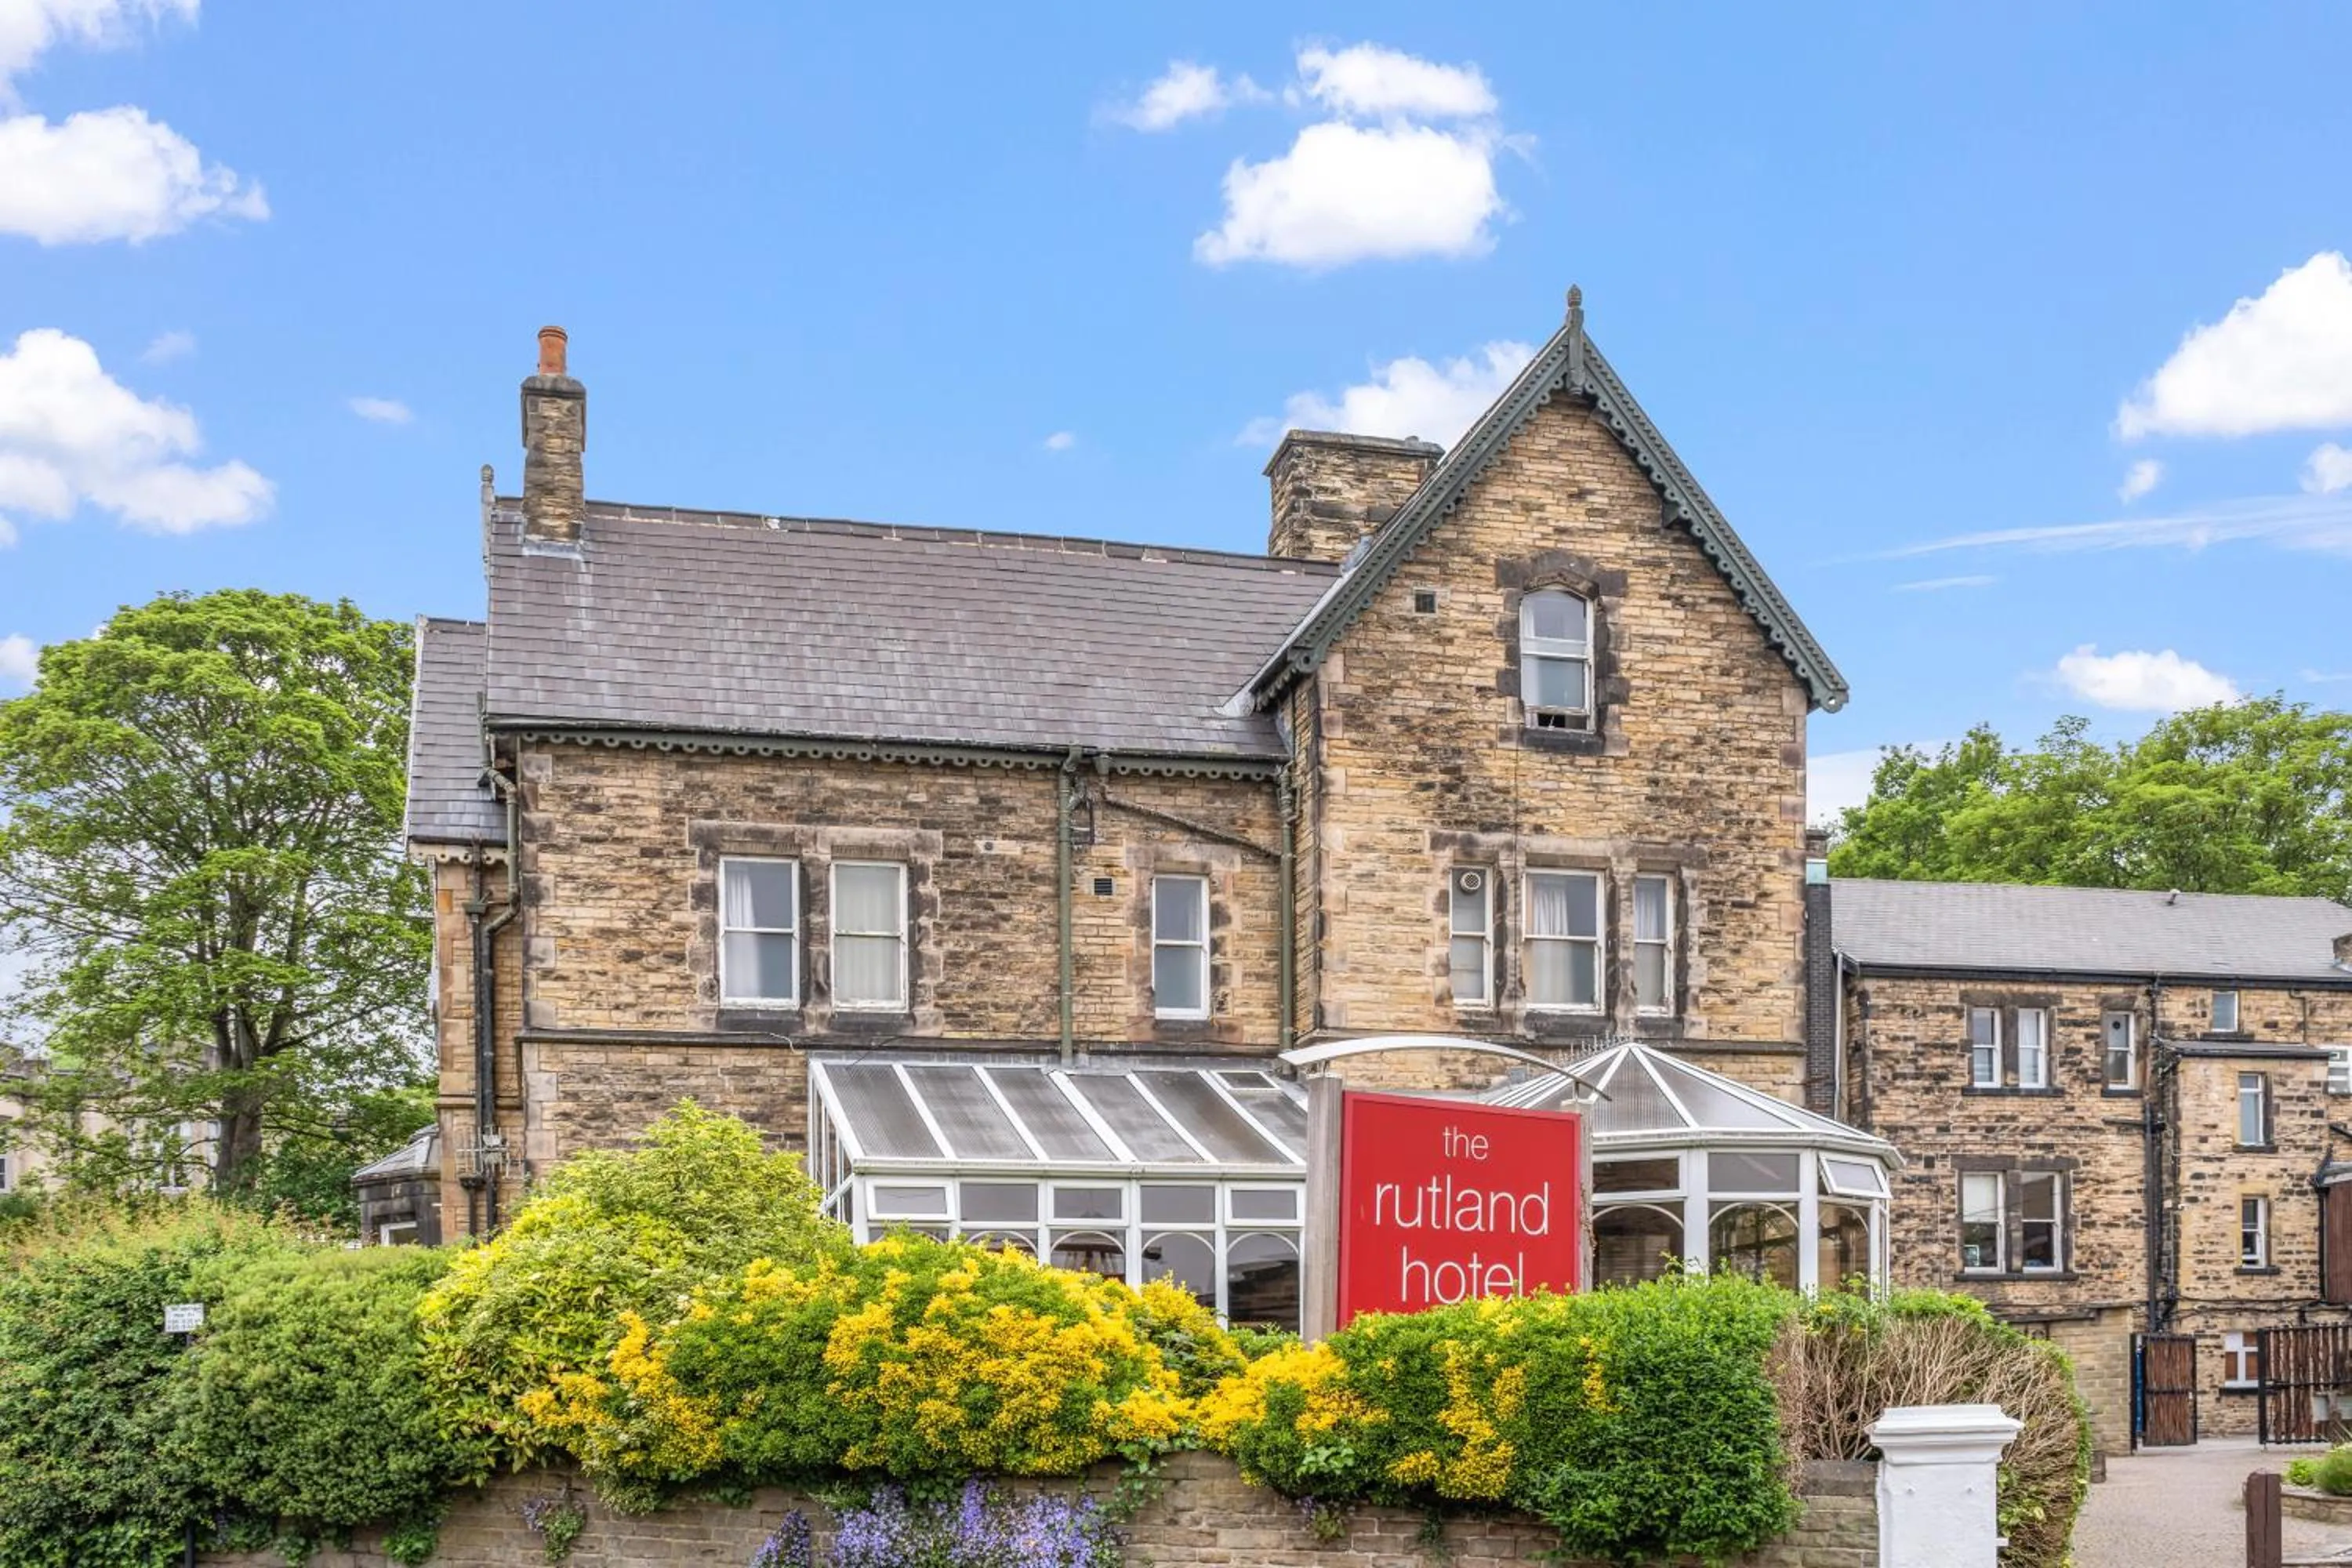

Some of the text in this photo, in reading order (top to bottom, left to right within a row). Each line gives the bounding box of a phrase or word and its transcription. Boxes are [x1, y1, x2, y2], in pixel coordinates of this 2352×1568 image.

[1443, 1125, 1489, 1160] the
[1374, 1174, 1549, 1236] rutland
[1401, 1246, 1523, 1305] hotel
